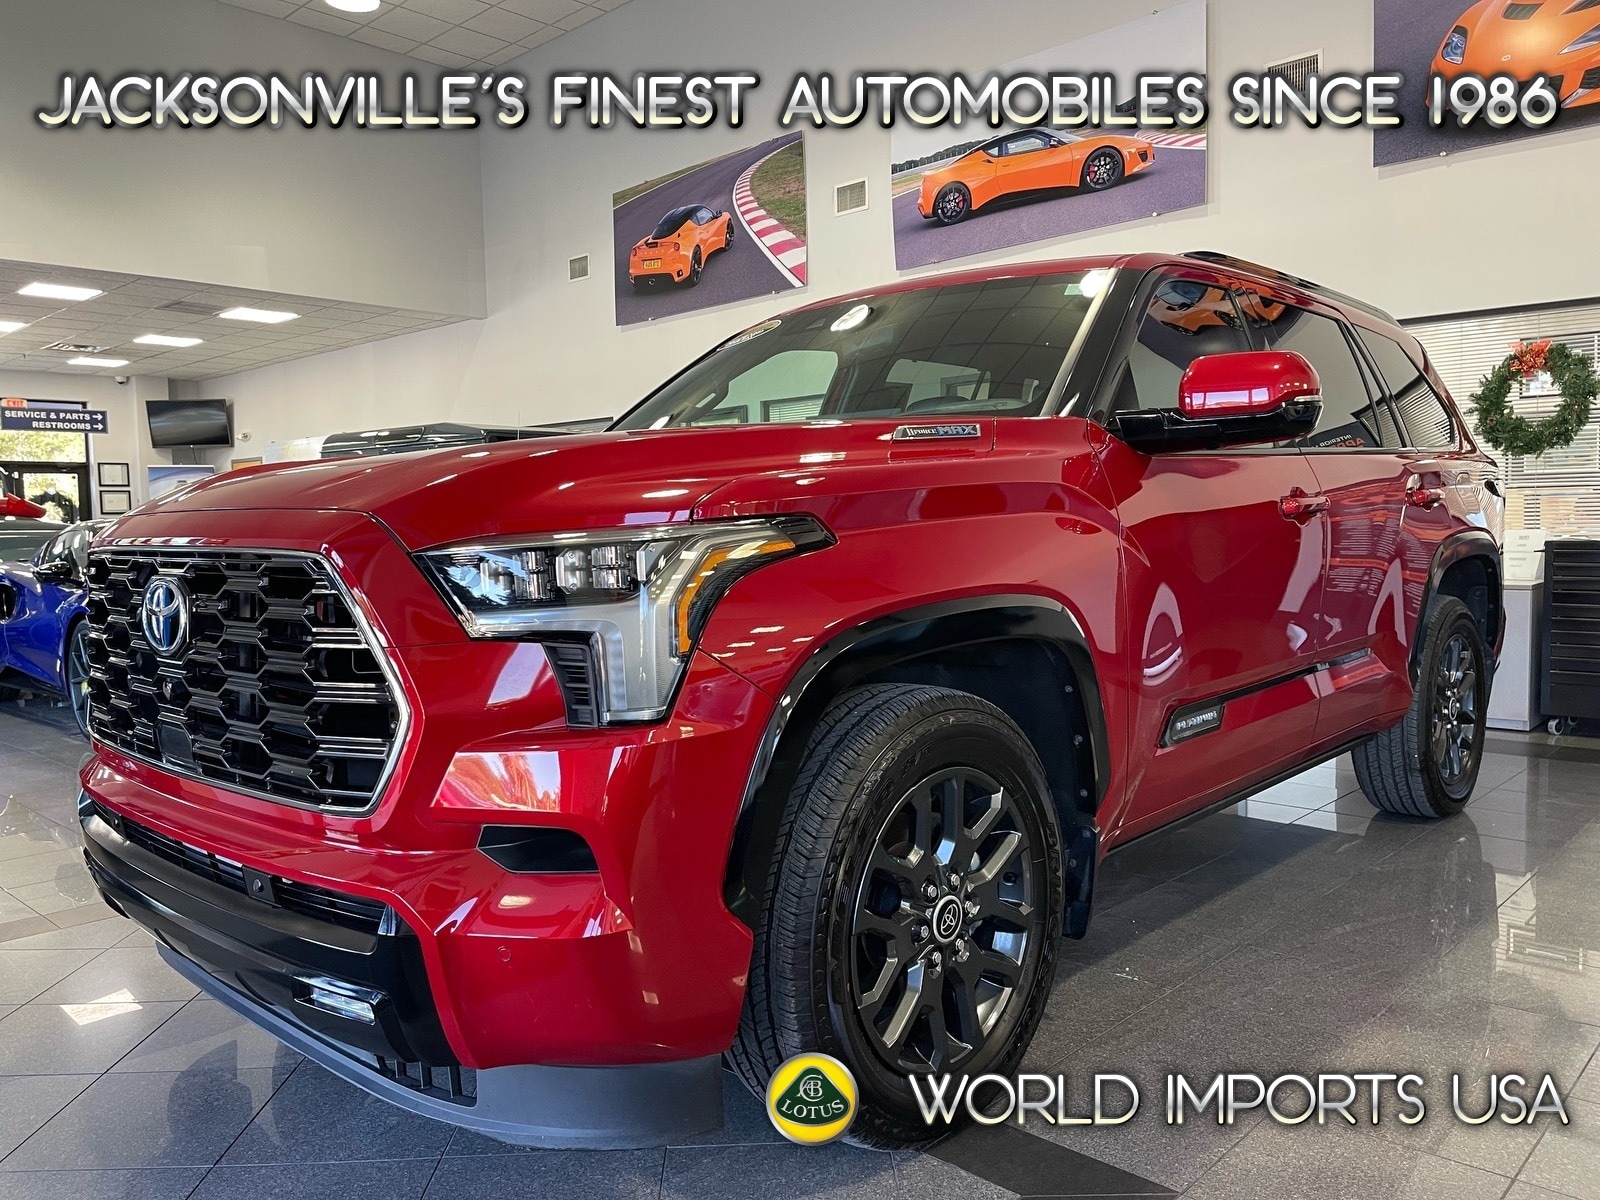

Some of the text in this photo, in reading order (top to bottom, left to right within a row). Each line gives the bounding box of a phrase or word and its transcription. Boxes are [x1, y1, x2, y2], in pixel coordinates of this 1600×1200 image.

[4, 410, 47, 419] SERVICE
[60, 412, 91, 420] PARTS
[32, 421, 91, 430] RESTROOMS
[937, 425, 976, 435] MAX
